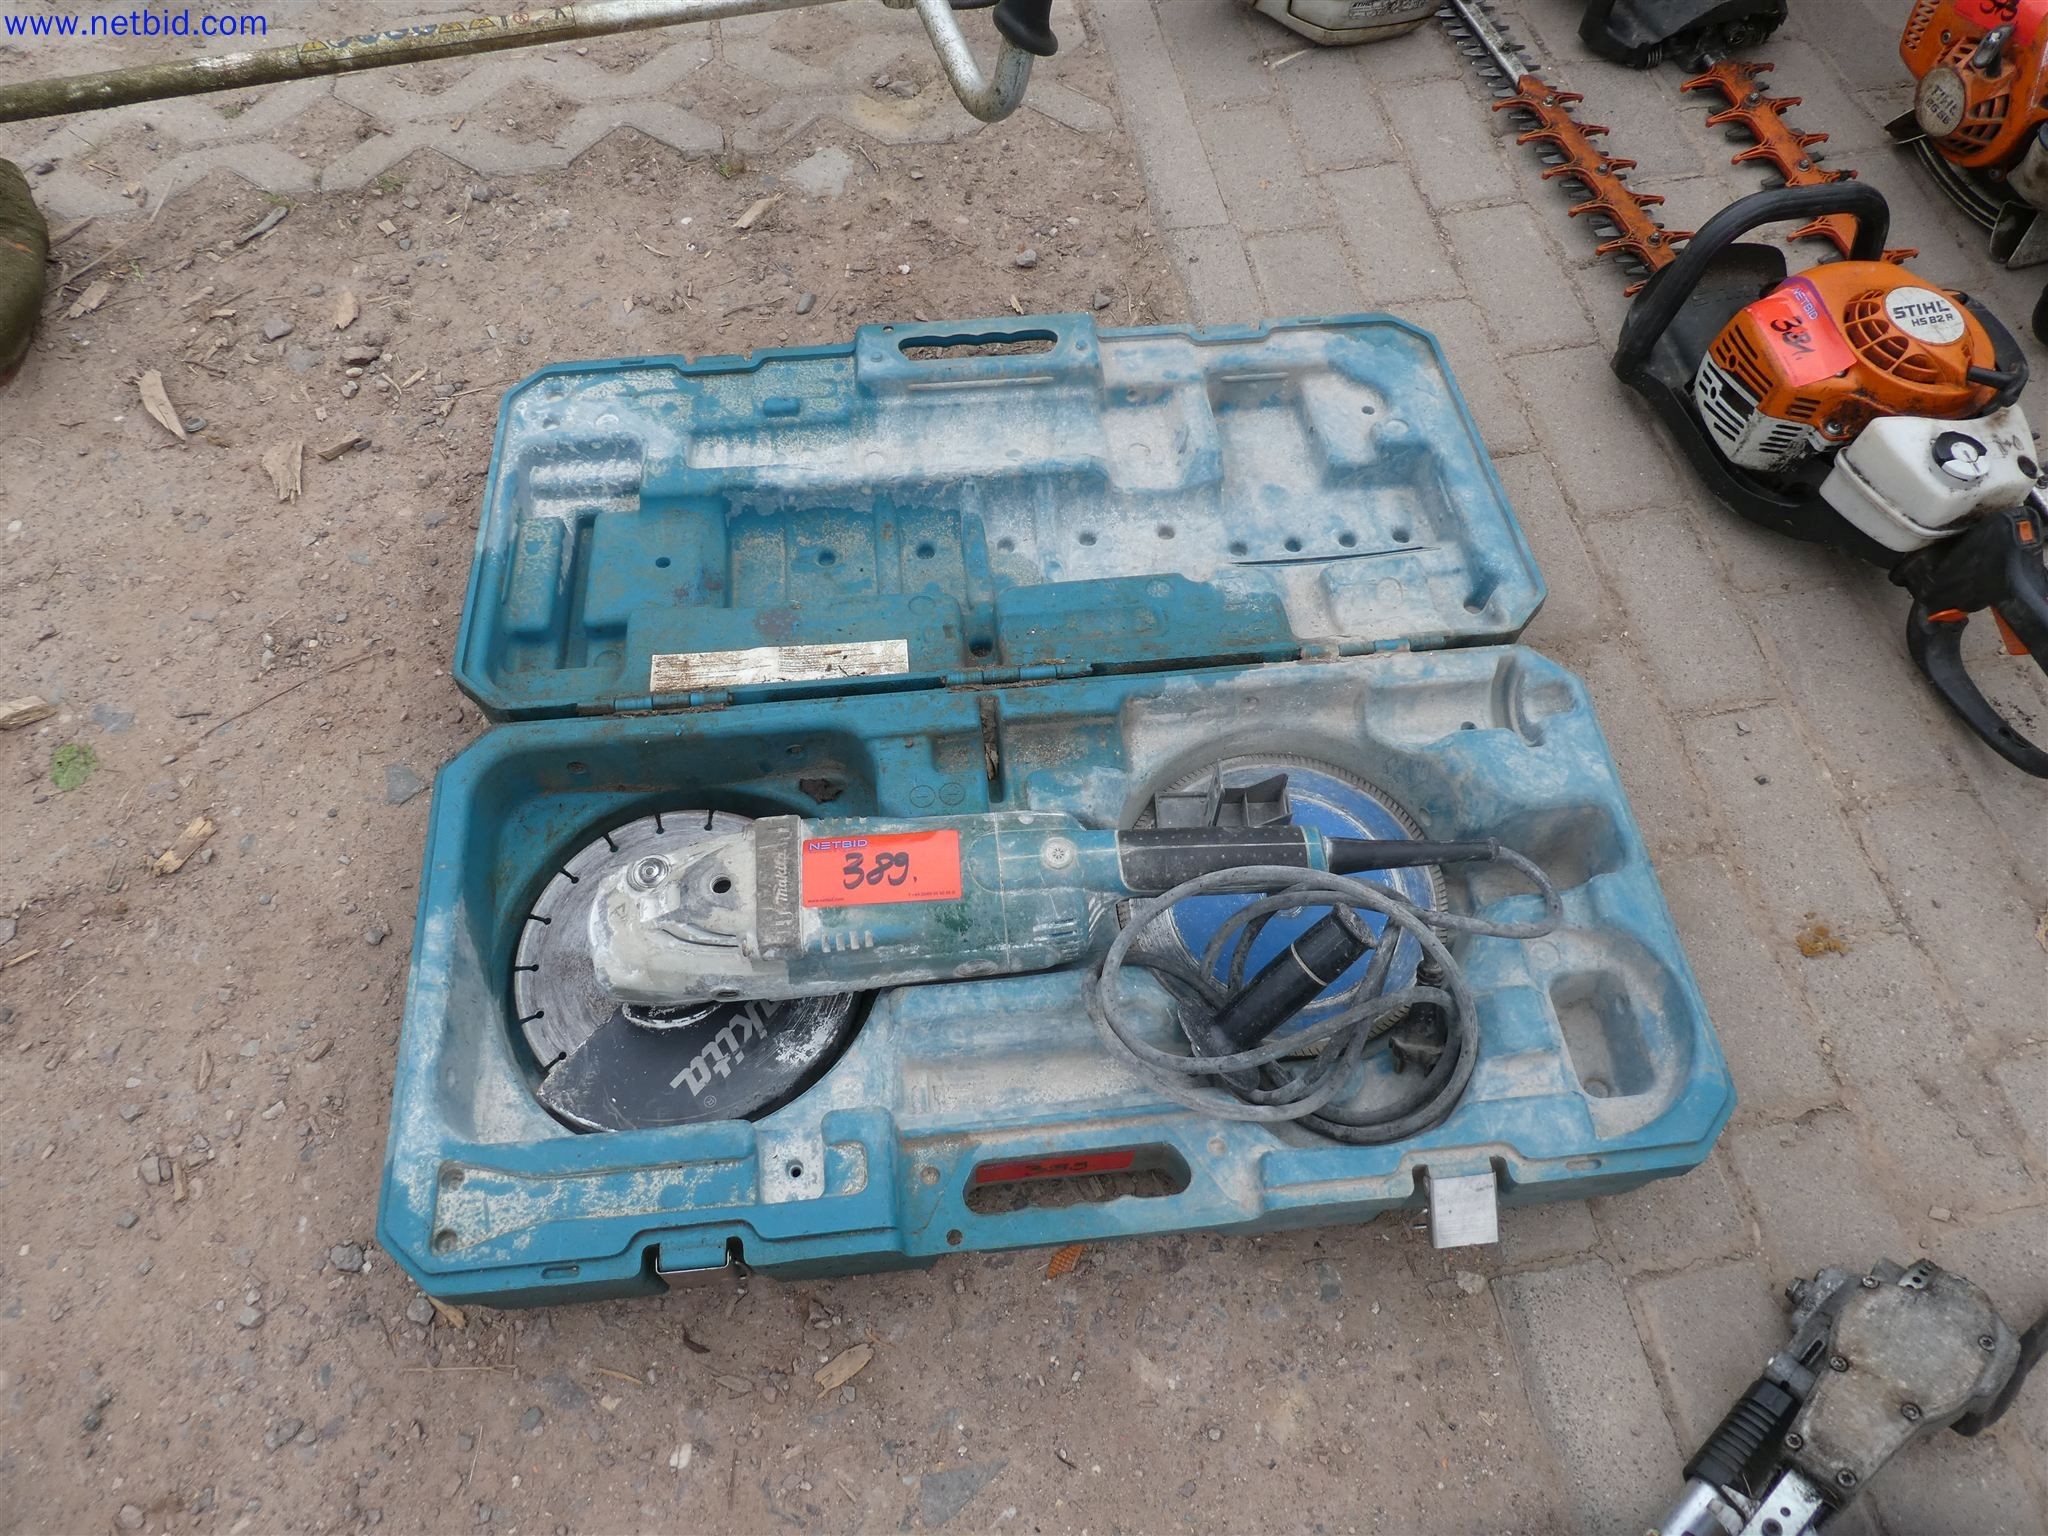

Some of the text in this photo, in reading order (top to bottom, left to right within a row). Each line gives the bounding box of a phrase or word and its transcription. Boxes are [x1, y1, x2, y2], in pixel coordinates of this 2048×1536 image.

[1792, 287, 1819, 321] NETBID
[1892, 300, 1950, 320] STIHL
[1911, 317, 1928, 327] HS
[1945, 313, 1955, 322] R
[808, 838, 869, 851] NETBID
